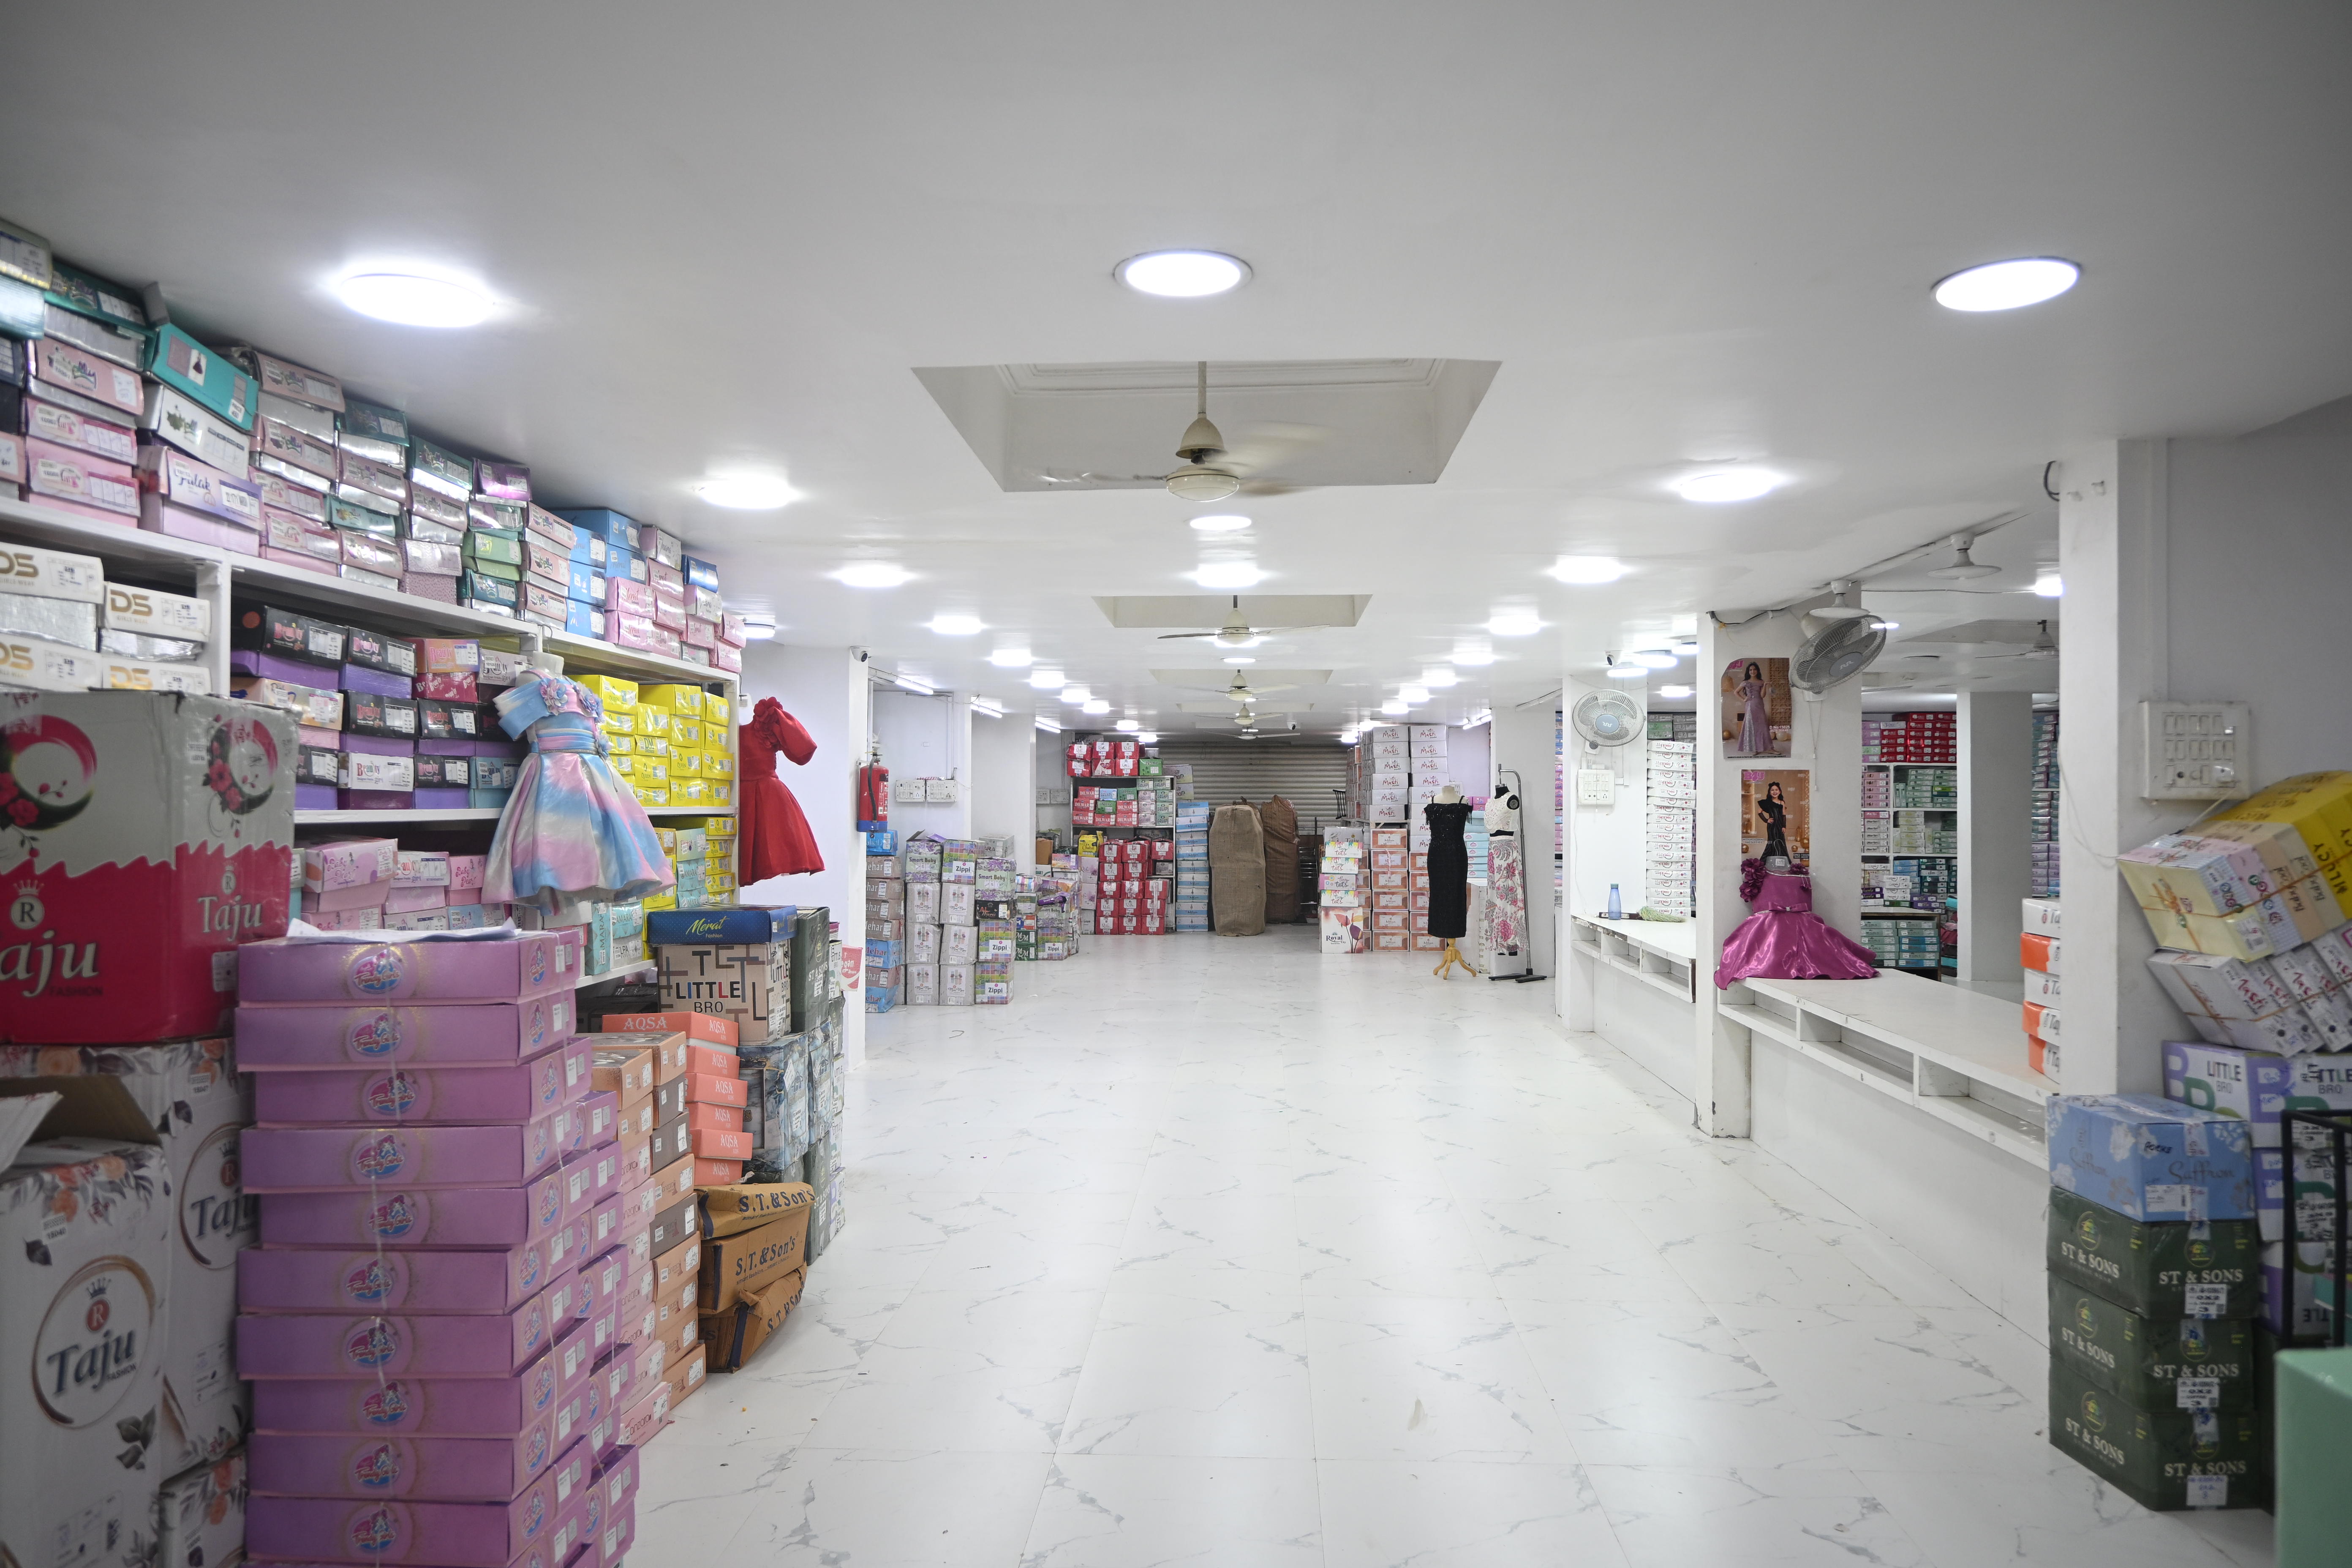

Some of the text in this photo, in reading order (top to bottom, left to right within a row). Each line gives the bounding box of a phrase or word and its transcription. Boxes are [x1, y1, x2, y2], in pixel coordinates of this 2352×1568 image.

[0, 550, 39, 577] DS
[110, 589, 153, 617] DS
[430, 646, 454, 663] Beauty
[110, 665, 153, 690] DS
[645, 738, 654, 749] DM
[357, 762, 380, 776] Beauty
[1744, 771, 1764, 781] B4U
[956, 866, 970, 874] Zippi
[20, 902, 35, 923] R
[198, 894, 263, 942] Taju
[686, 916, 730, 935] Merat
[0, 930, 98, 998] aju
[819, 961, 828, 974] SONS
[772, 963, 789, 983] LITTLE
[49, 986, 103, 997] FASHION
[676, 981, 741, 999] LITTLE
[694, 1002, 724, 1013] BRO
[623, 1017, 667, 1030] AQSA
[709, 1020, 726, 1034] AQSA
[712, 1054, 727, 1067] AQSA
[2207, 1061, 2242, 1082] LITTLE
[716, 1080, 734, 1094] AQSA
[2216, 1081, 2233, 1094] BRO
[715, 1110, 731, 1122] AQSA
[720, 1134, 738, 1147] AQSA
[713, 1162, 730, 1176] AQSA
[2169, 1160, 2235, 1183] Saffron
[2061, 1241, 2120, 1279] ST SONS
[2159, 1269, 2244, 1284] ST & SONS
[2061, 1328, 2115, 1369] ST & SONS
[46, 1329, 136, 1397] Taju
[2154, 1363, 2240, 1378] ST & SONS
[2065, 1417, 2125, 1465] ST & SONS
[2164, 1460, 2247, 1477] ST & SONS
